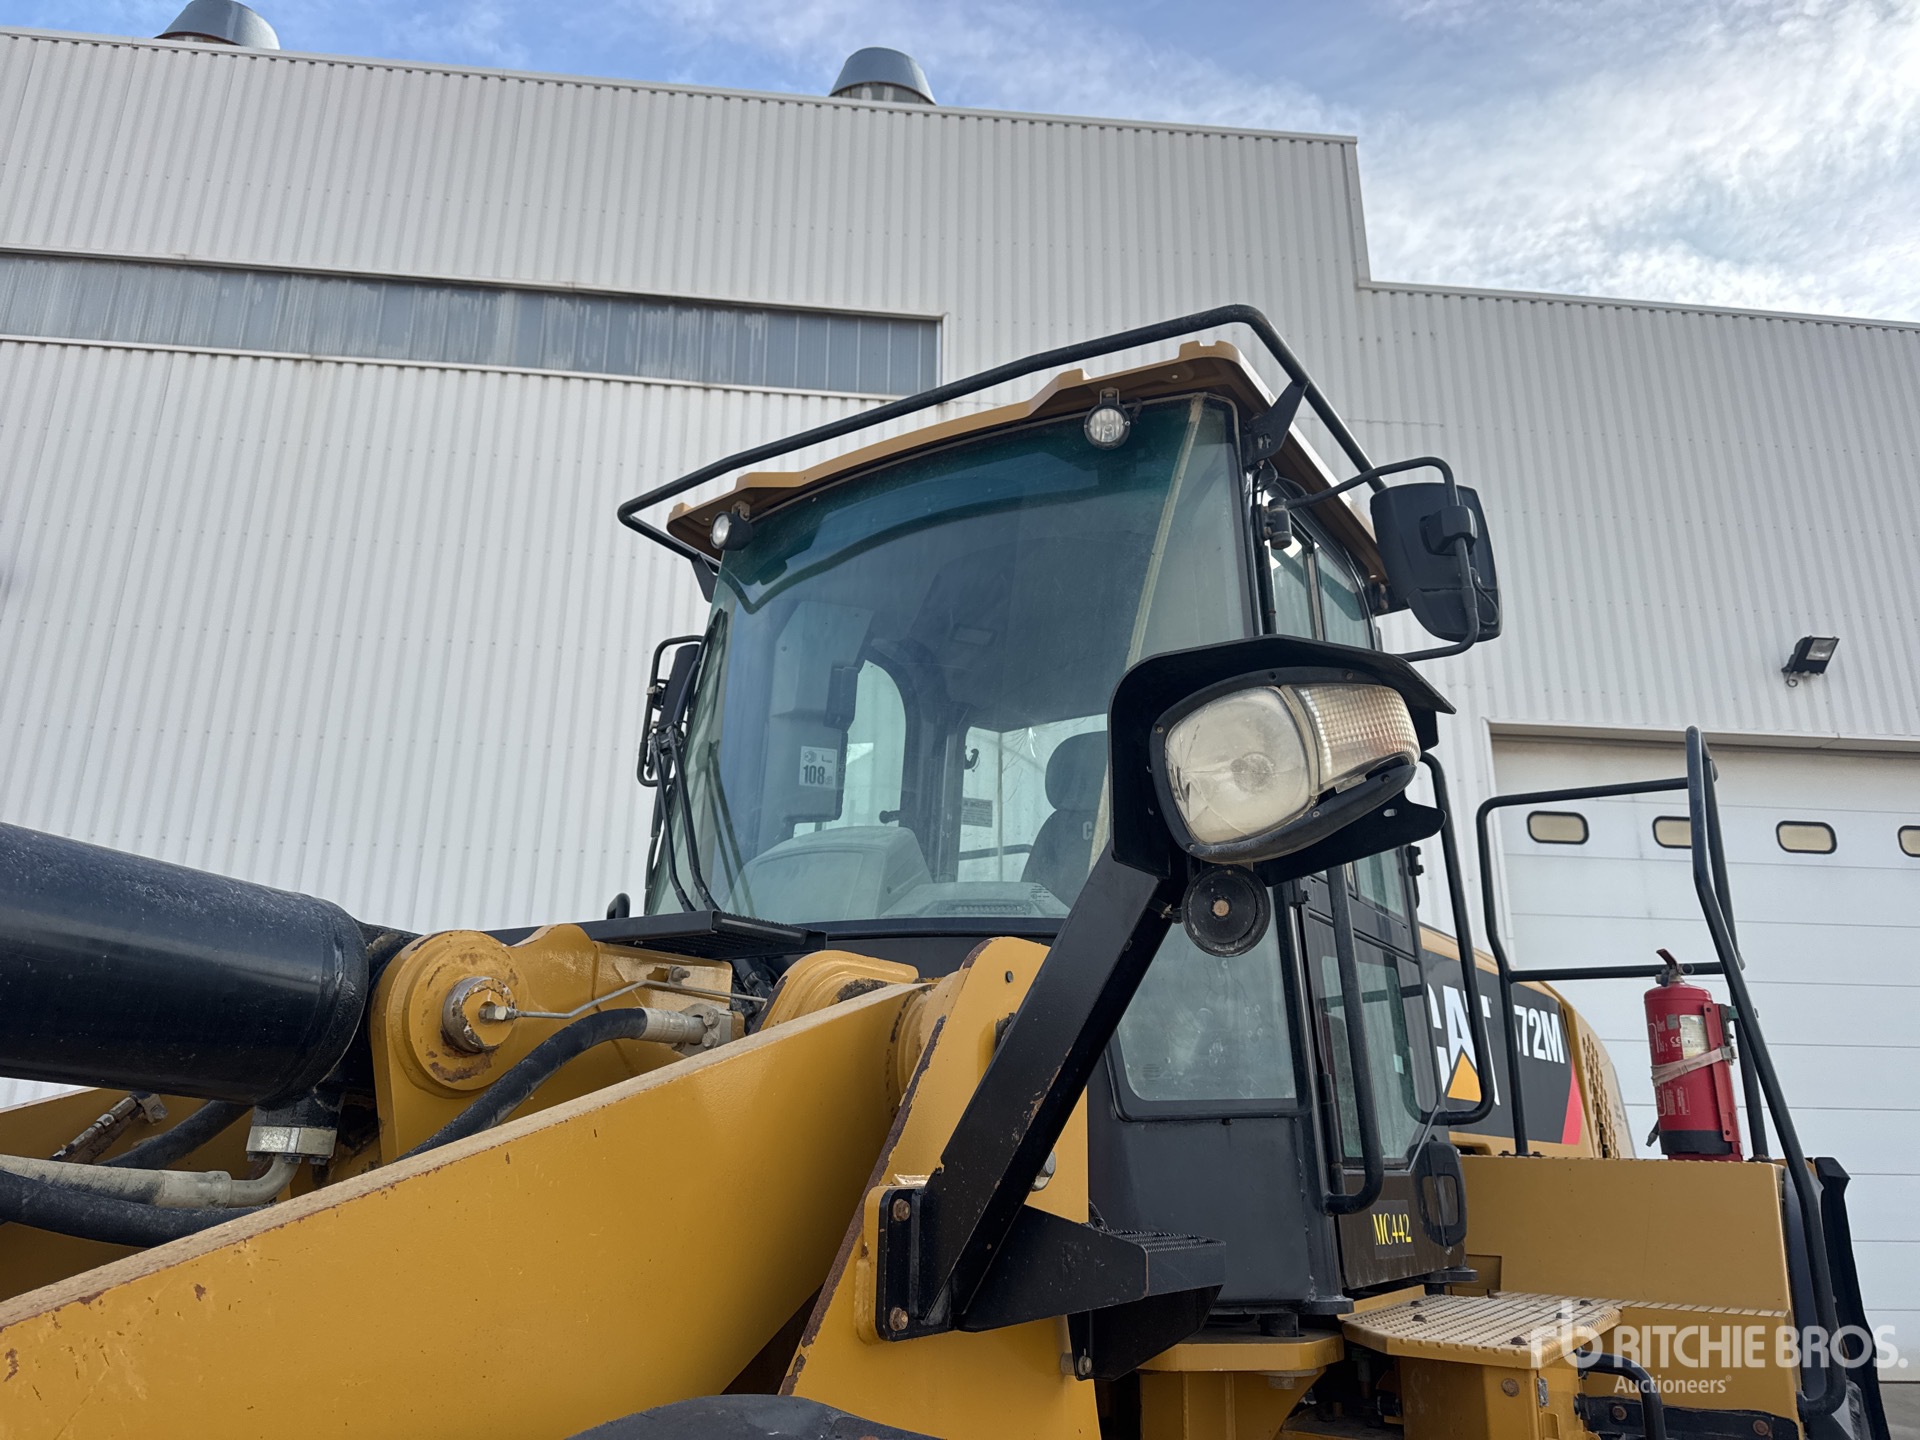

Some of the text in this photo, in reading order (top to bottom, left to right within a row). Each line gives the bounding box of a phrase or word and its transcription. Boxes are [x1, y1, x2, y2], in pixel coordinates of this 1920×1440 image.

[803, 765, 826, 785] 108
[1513, 1004, 1565, 1064] 72M
[1372, 1212, 1412, 1246] MC442
